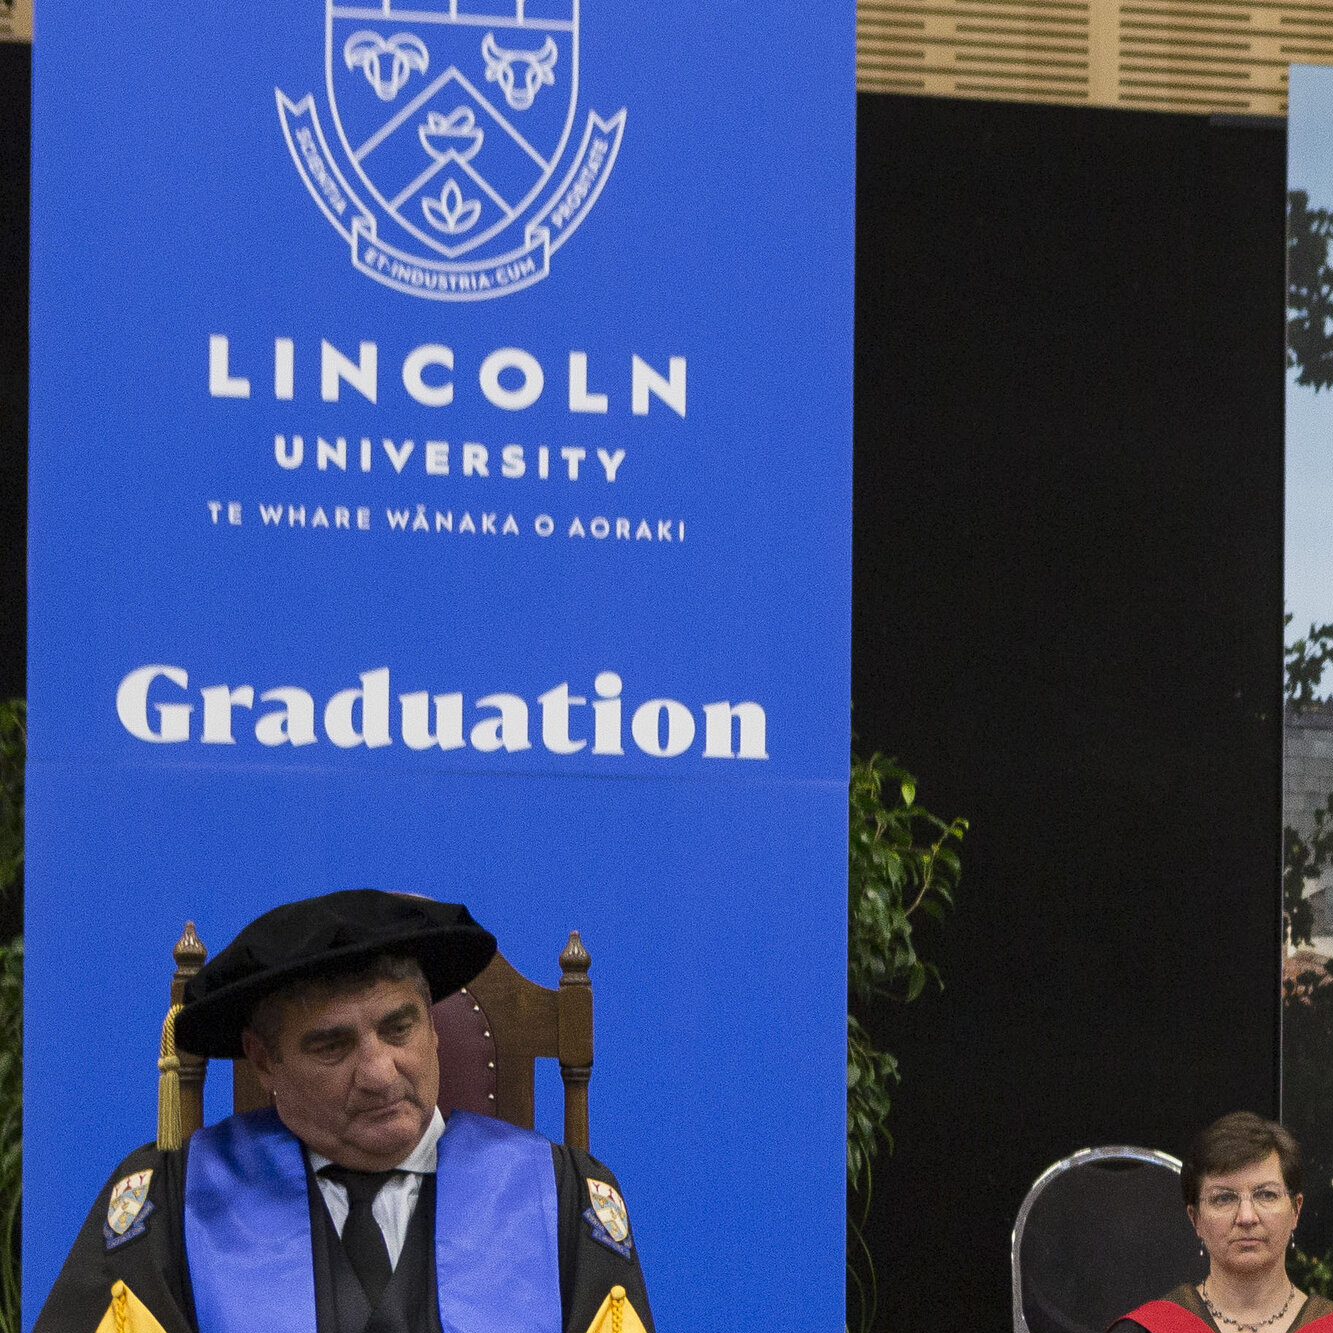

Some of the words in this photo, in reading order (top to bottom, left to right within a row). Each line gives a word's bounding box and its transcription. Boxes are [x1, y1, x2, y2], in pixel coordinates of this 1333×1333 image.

[208, 334, 687, 418] LINCOLN
[274, 435, 626, 482] UNIVERSITY
[208, 501, 242, 525] TE
[259, 504, 370, 530] WHARE
[534, 514, 555, 537] O
[568, 516, 685, 542] AORAKI
[115, 663, 769, 760] Graduation
